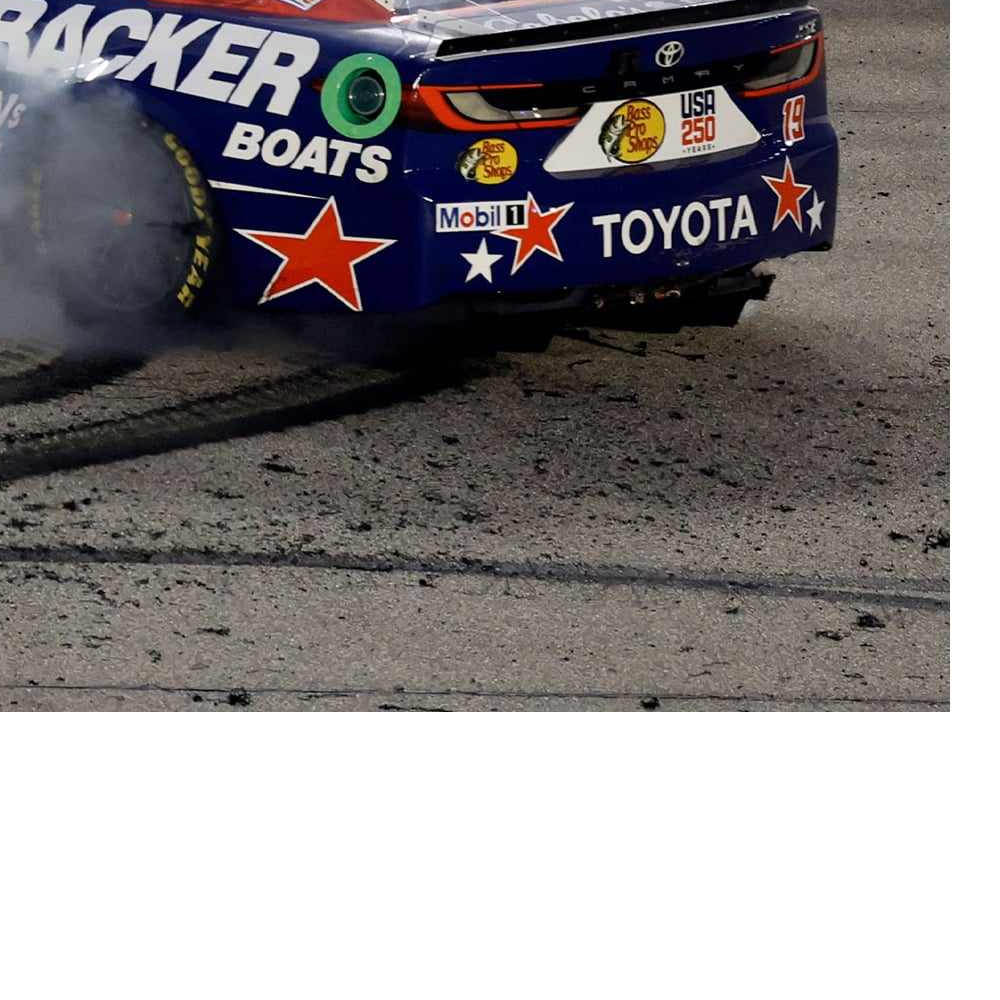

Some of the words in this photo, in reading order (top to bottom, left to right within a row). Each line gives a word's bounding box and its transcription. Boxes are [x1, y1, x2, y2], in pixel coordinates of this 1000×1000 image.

[581, 62, 745, 95] CAMRY
[624, 104, 651, 122] Bass
[680, 89, 716, 119] USA
[627, 120, 647, 138] Pro
[681, 115, 716, 146] 250
[784, 96, 805, 142] 19
[222, 121, 392, 184] BOATS
[482, 141, 506, 154] Bass
[627, 136, 659, 154] Shops
[686, 144, 711, 154] YEARS
[481, 152, 501, 167] Pro
[484, 164, 513, 180] Shops
[164, 133, 213, 309] GOODYEAR
[440, 205, 501, 229] Mobil
[510, 205, 519, 225] 1
[593, 195, 758, 258] TOYOTA
